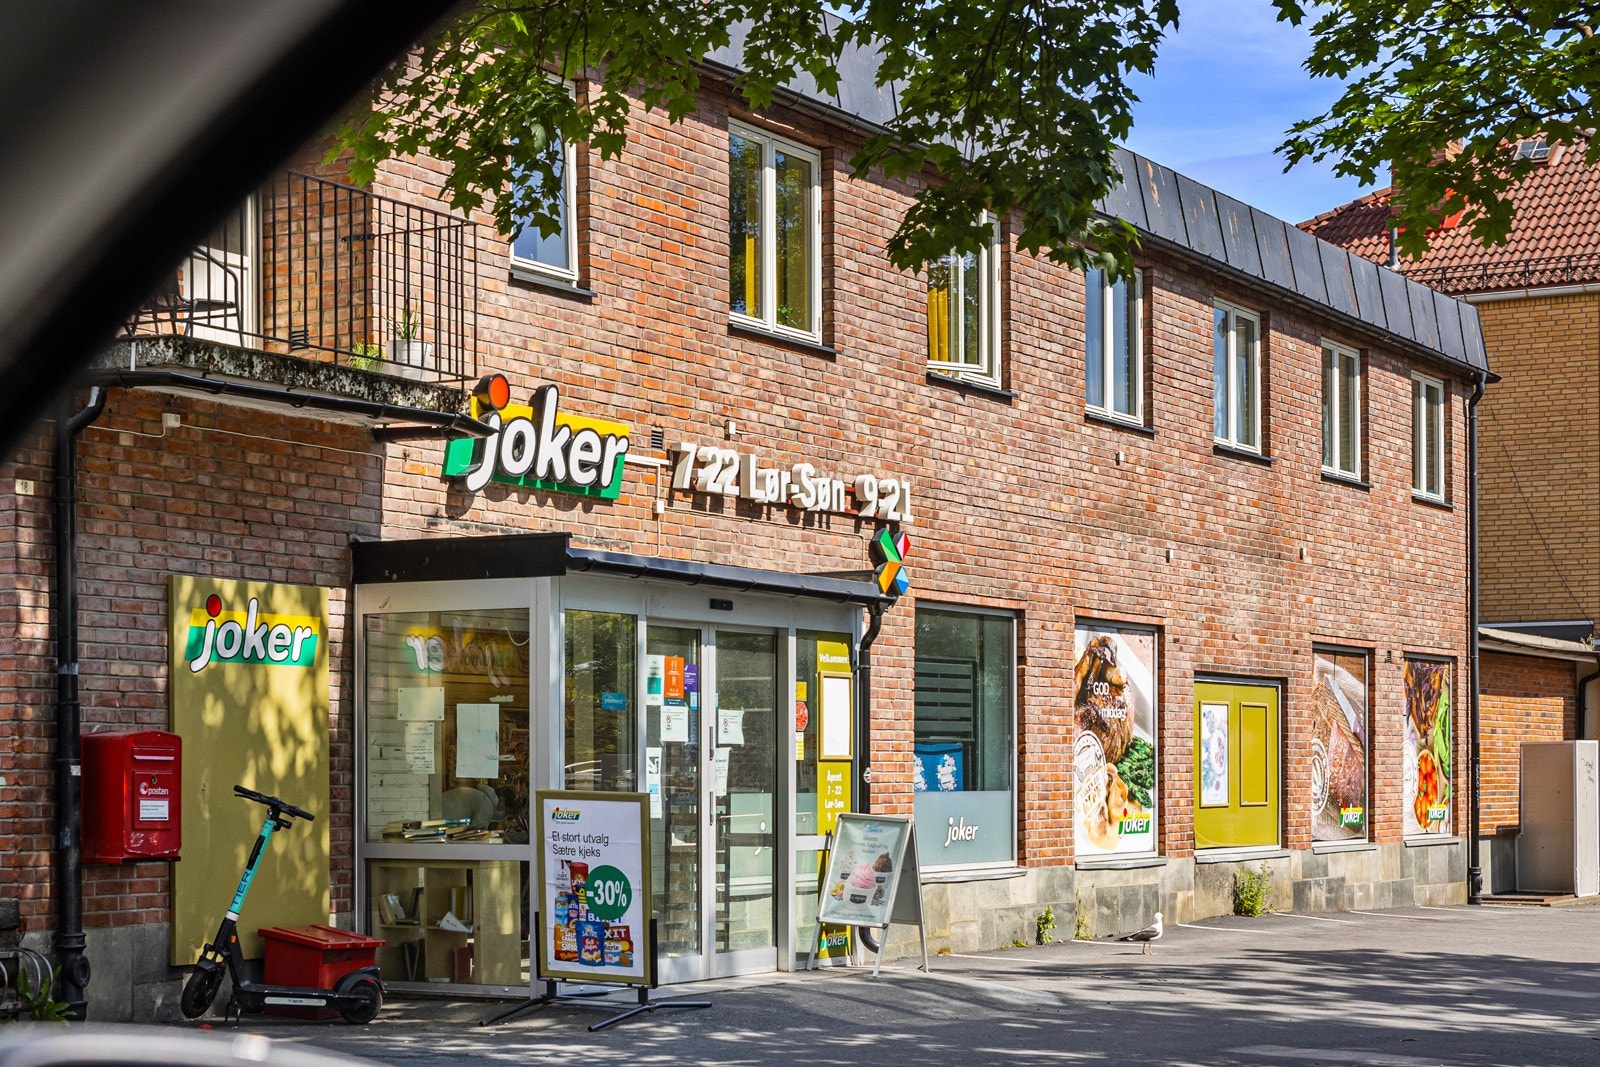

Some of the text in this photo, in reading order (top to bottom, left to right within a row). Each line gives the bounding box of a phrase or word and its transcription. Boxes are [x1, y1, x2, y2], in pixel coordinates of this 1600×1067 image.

[466, 373, 629, 494] joker
[672, 442, 914, 522] 7-22 Lør-Søn 9-21
[190, 594, 312, 673] joker
[1093, 682, 1109, 695] GOD
[148, 787, 169, 796] posten
[552, 807, 578, 821] joker
[1119, 808, 1149, 839] joker
[1340, 803, 1361, 829] joker
[1427, 801, 1445, 823] joker
[552, 830, 609, 847] Et stort utvalg
[944, 817, 979, 847] joker
[552, 843, 601, 860] Sætre kjeks
[229, 870, 252, 907] TIER
[586, 879, 627, 907] -30%
[604, 928, 627, 939] XIT
[821, 928, 846, 952] joker
